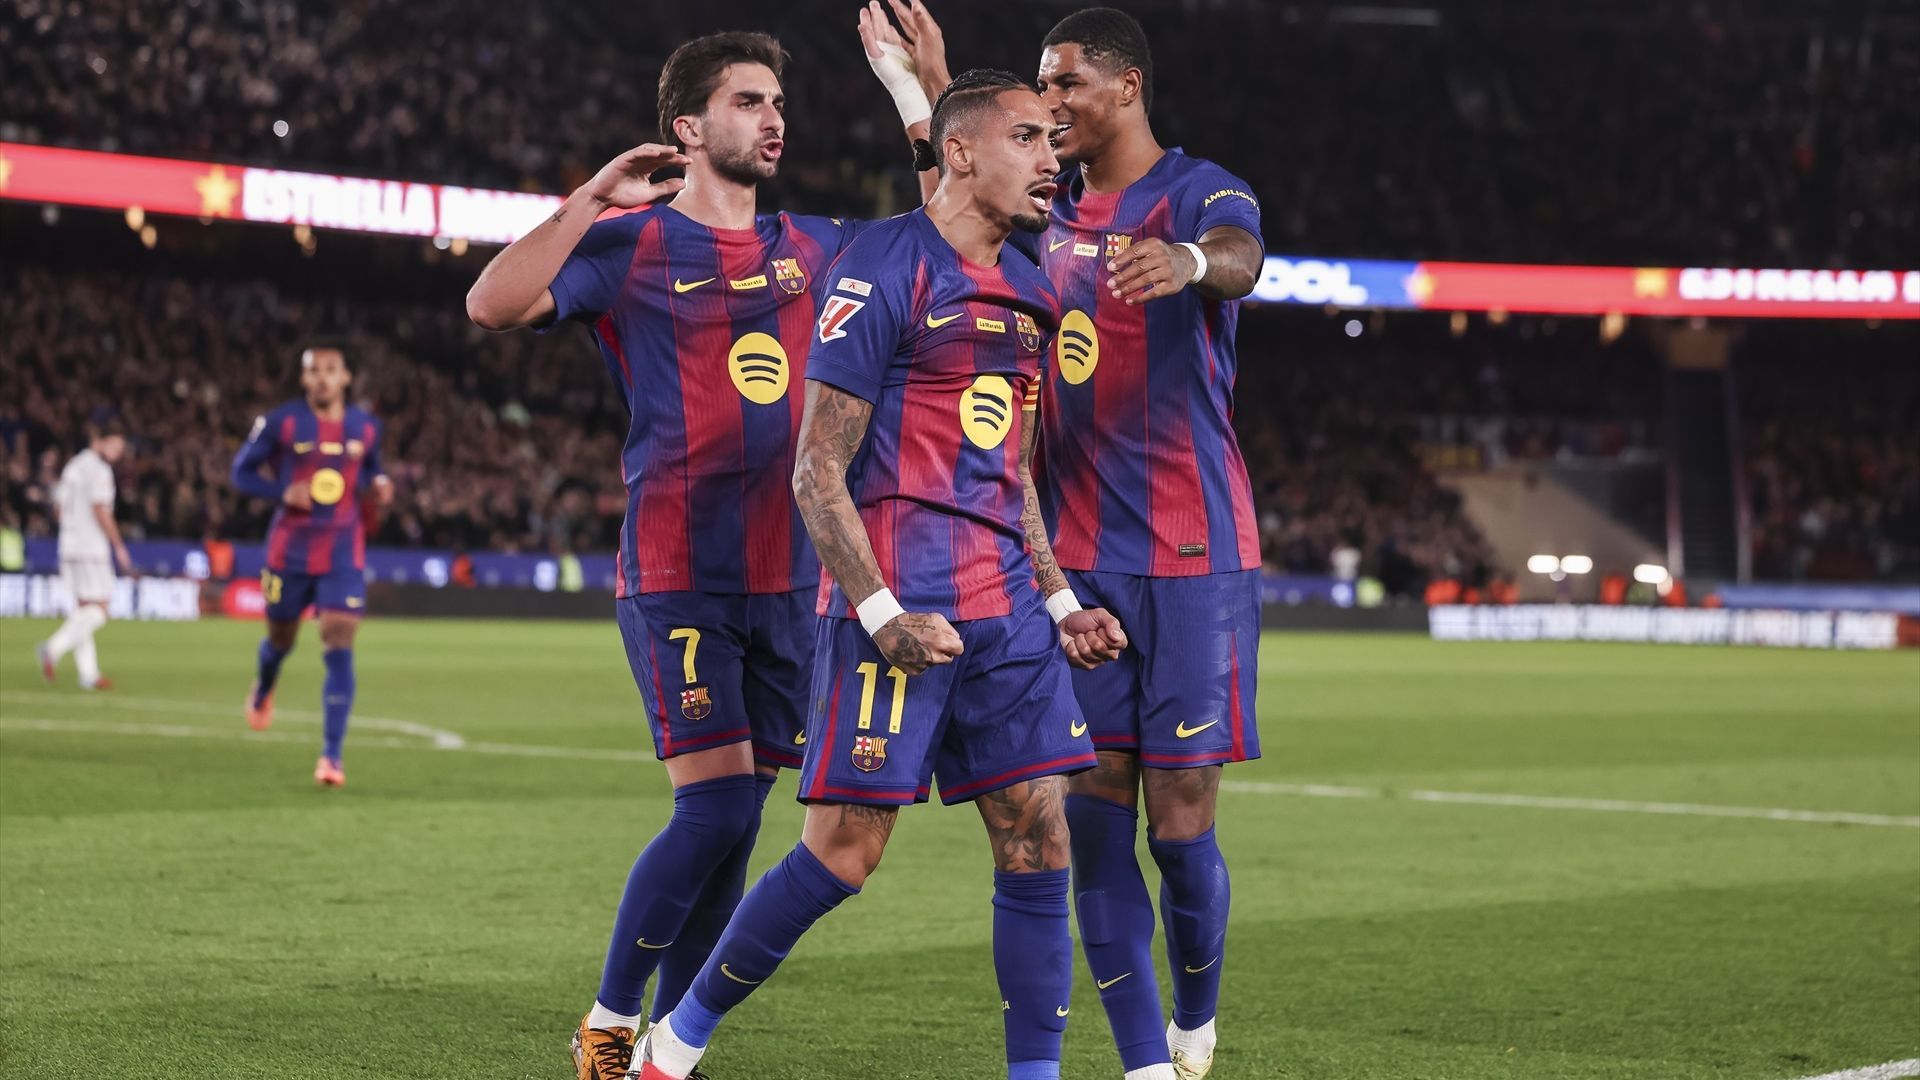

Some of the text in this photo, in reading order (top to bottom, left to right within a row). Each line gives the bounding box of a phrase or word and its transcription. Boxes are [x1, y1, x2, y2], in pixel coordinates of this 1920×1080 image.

[1204, 189, 1257, 207] AMBILIGHT
[669, 628, 701, 684] 7
[856, 662, 907, 734] 11
